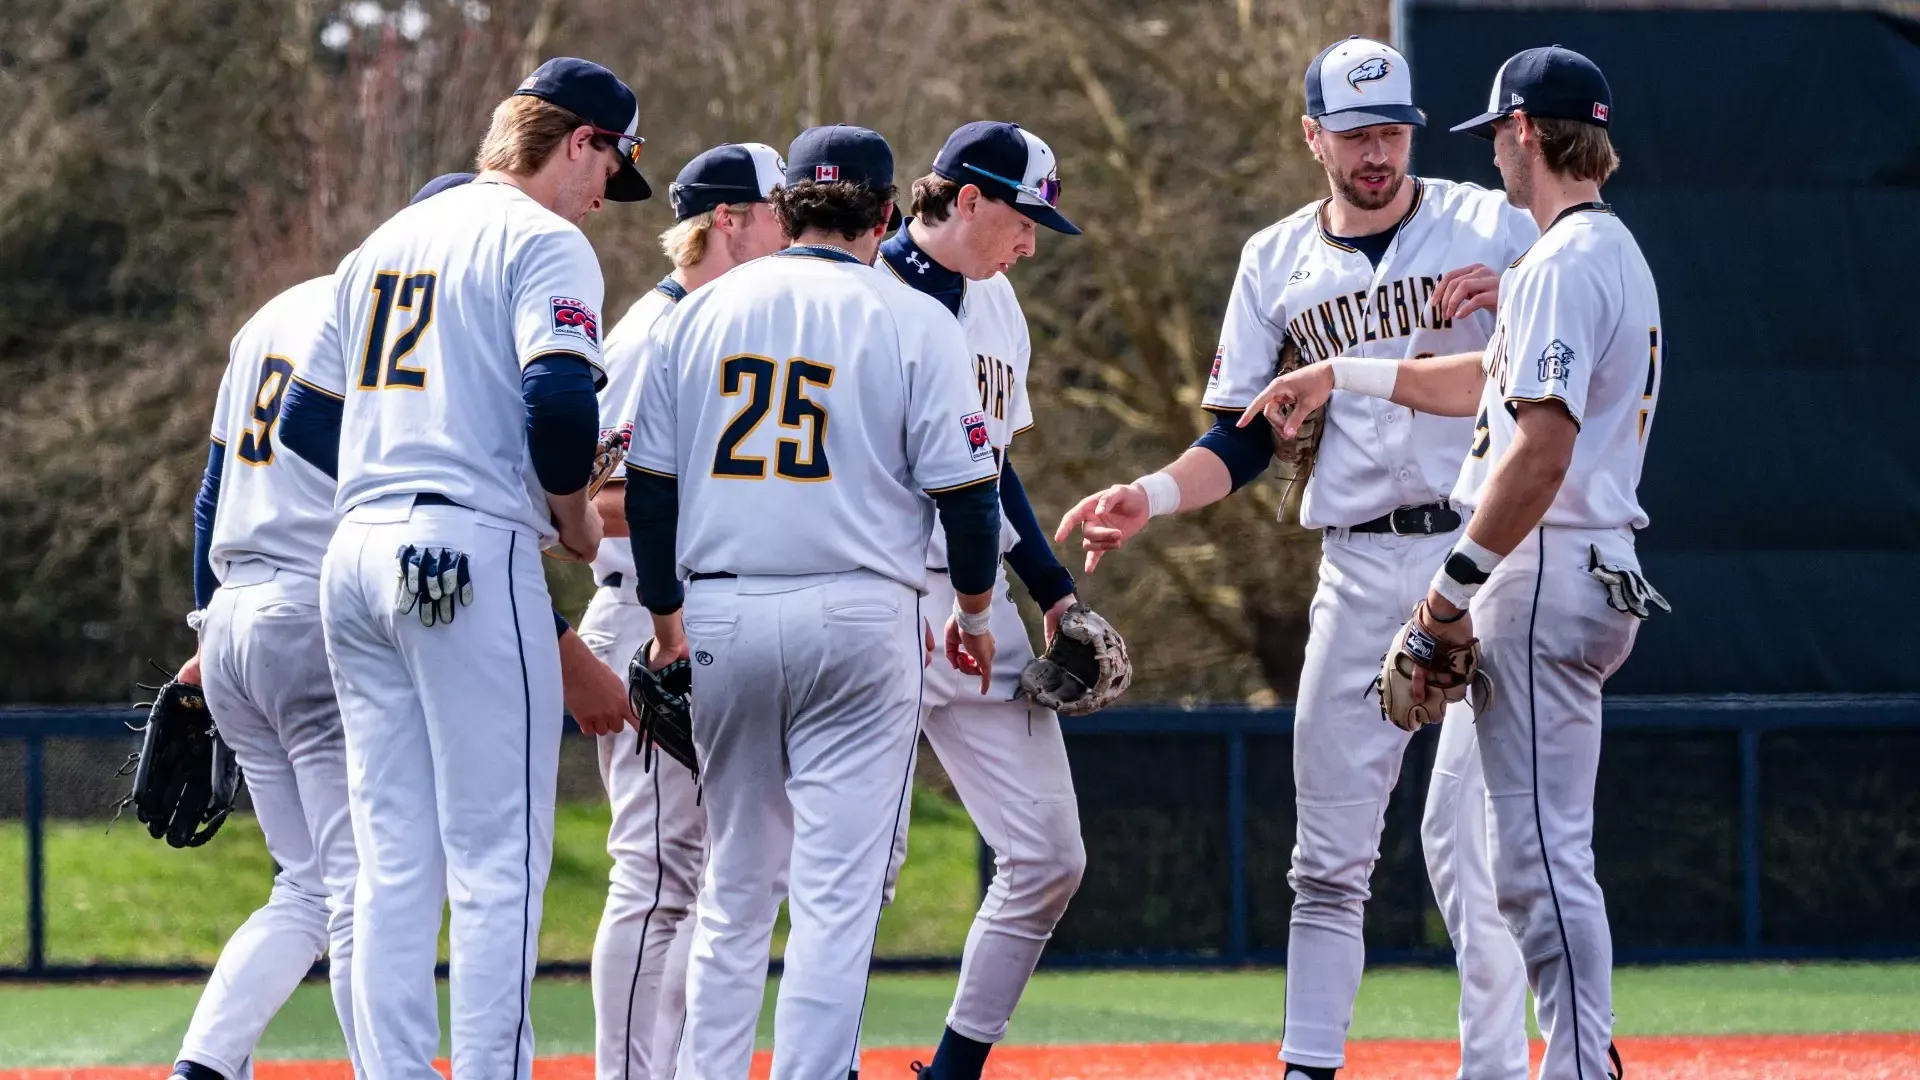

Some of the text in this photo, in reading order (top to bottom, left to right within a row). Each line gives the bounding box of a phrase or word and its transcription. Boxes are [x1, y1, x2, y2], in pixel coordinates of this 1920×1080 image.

[357, 270, 437, 392] 12
[1286, 273, 1453, 363] HUNDERBIR
[237, 354, 296, 466] 9
[711, 353, 836, 482] 25
